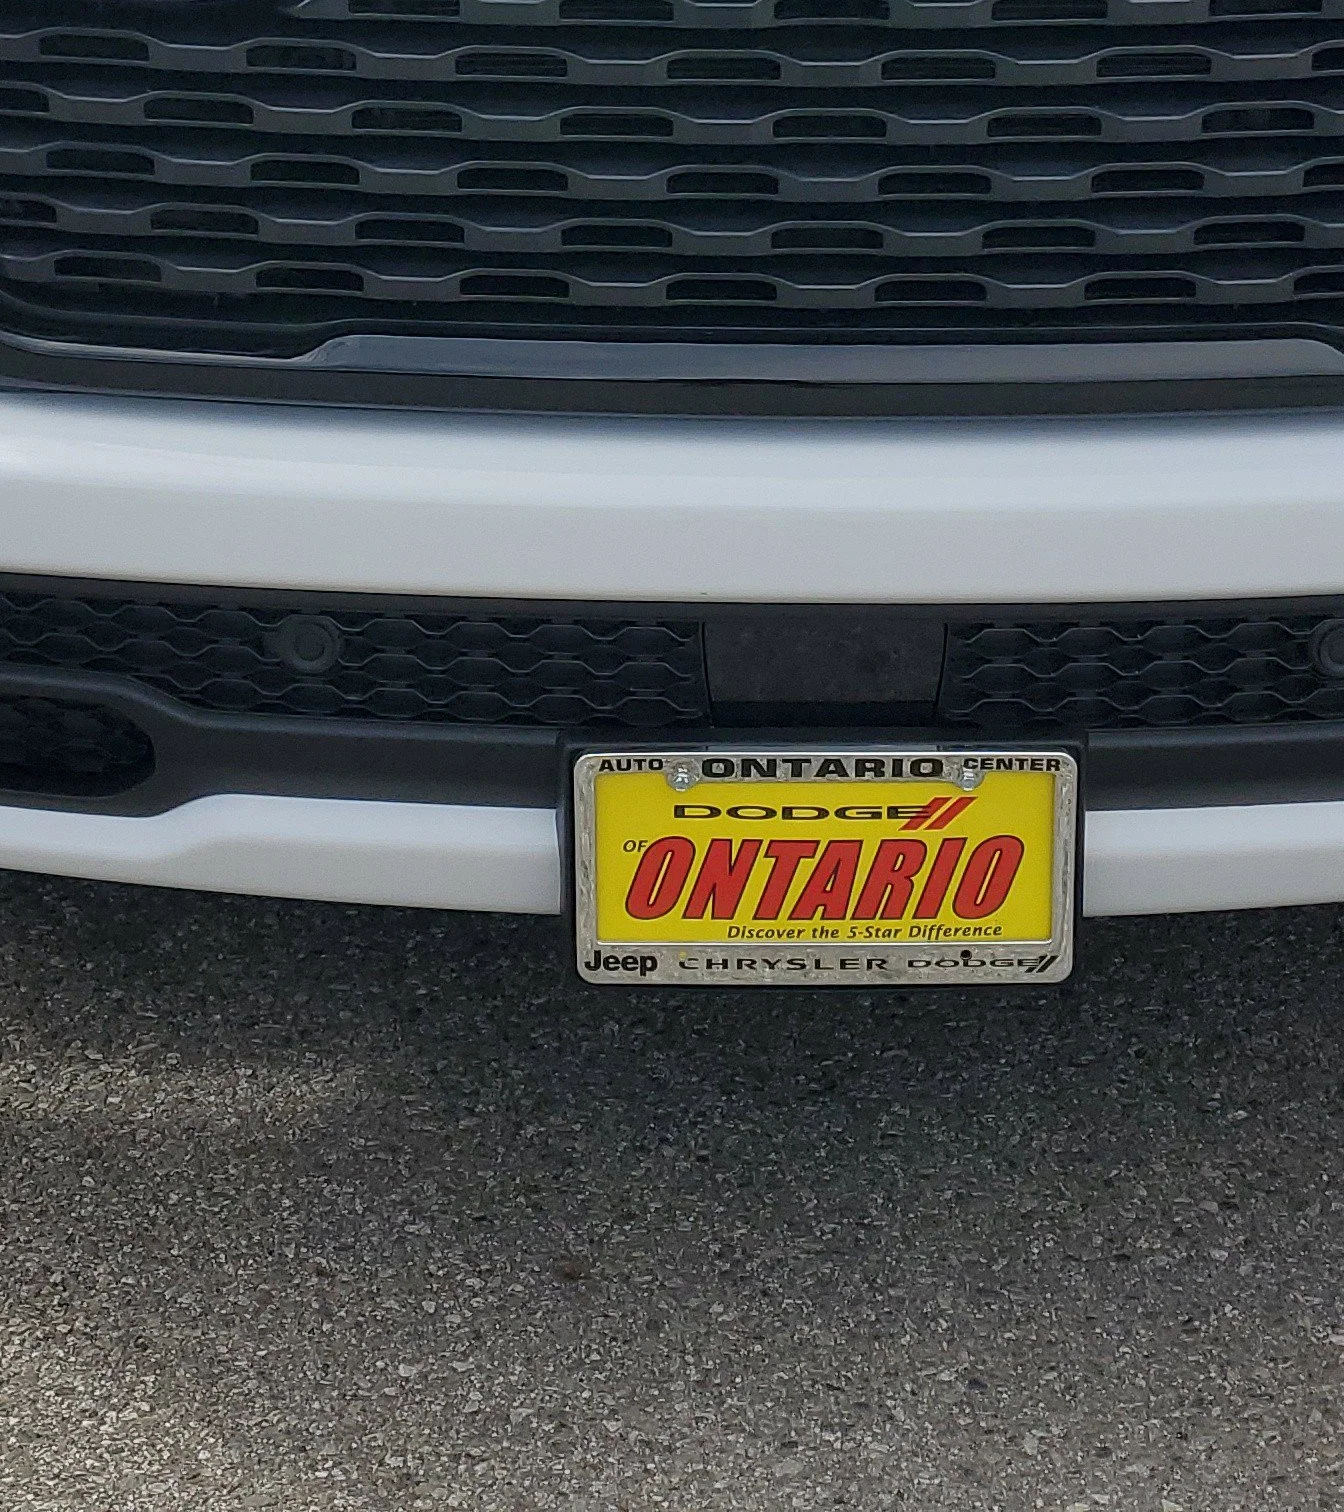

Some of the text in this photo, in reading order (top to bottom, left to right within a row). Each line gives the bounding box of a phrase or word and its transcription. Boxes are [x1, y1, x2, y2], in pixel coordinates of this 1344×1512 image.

[599, 757, 1061, 778] AUTO ONTARIO CENTER
[673, 804, 933, 821] DODGE
[622, 839, 649, 853] OF
[625, 835, 1025, 921] ONTARIO
[727, 923, 1003, 941] Discover the 5-Star Difference
[584, 949, 1042, 977] Jeep CHRYSLER DODGE
